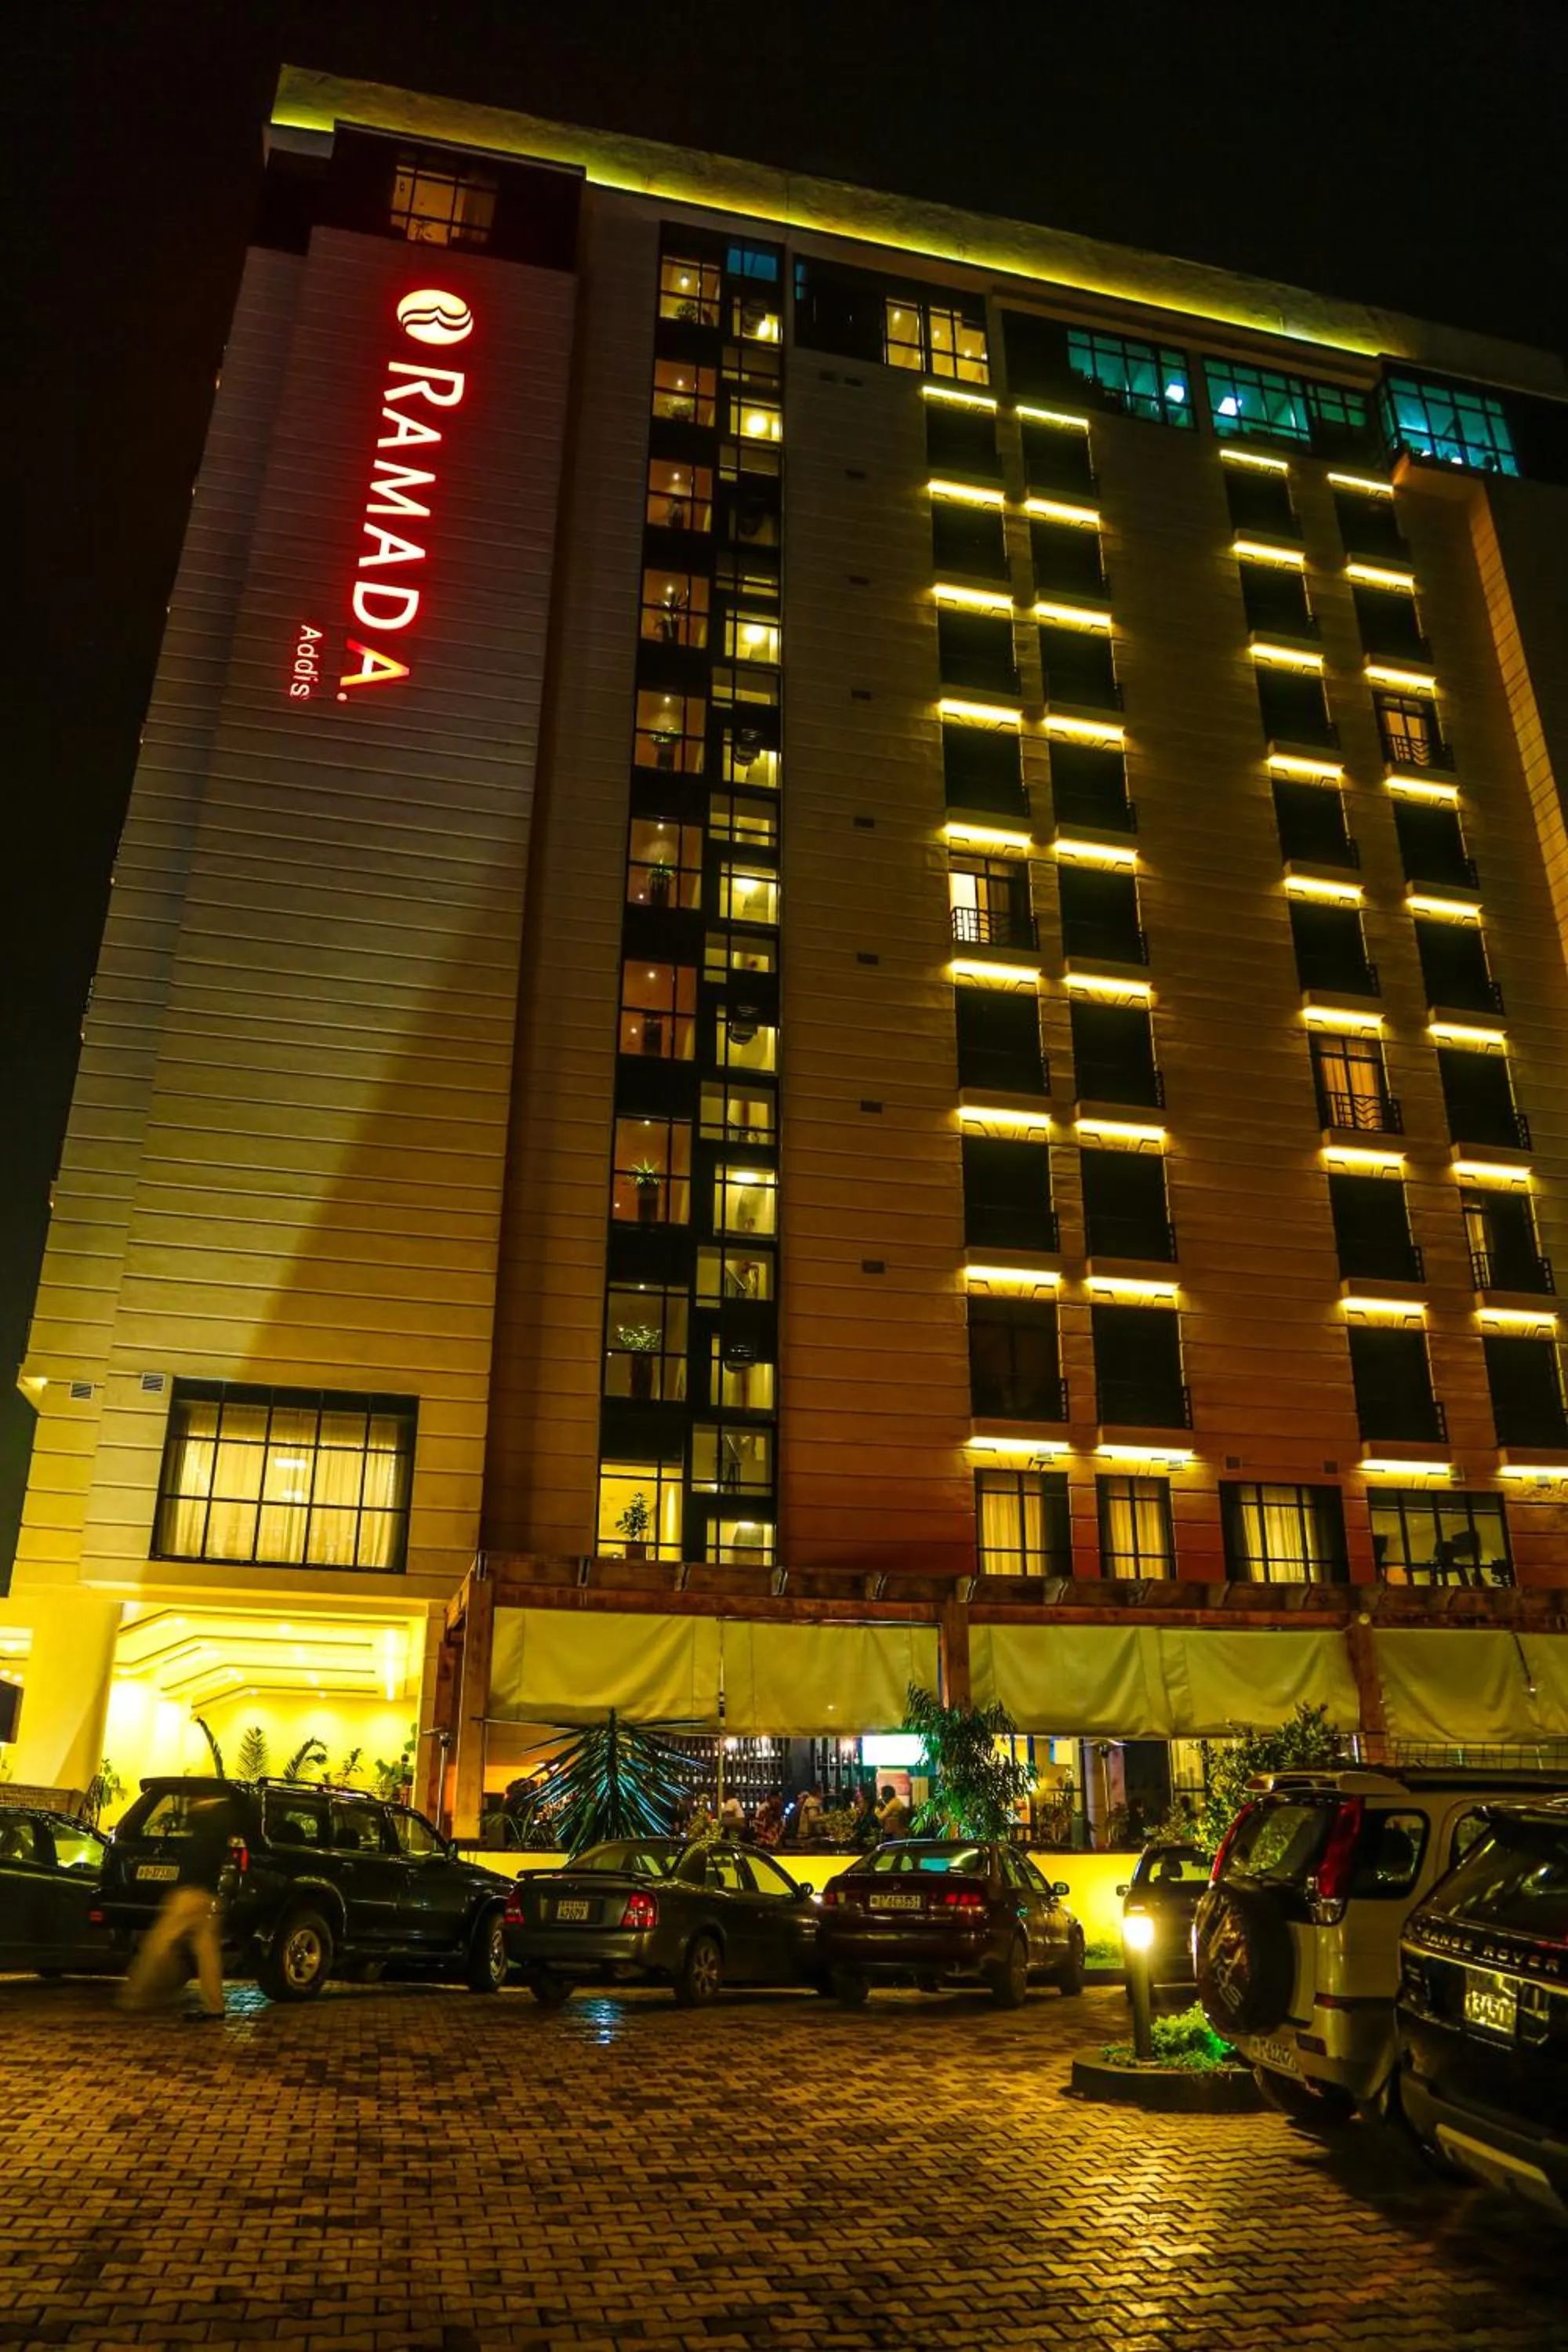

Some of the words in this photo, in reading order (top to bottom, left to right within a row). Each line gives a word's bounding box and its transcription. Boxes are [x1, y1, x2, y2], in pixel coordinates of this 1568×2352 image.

[340, 361, 465, 687] RAMADA
[290, 625, 323, 697] Addis
[1421, 1929, 1473, 1951] RANGE
[1483, 1945, 1559, 1973] ROVER
